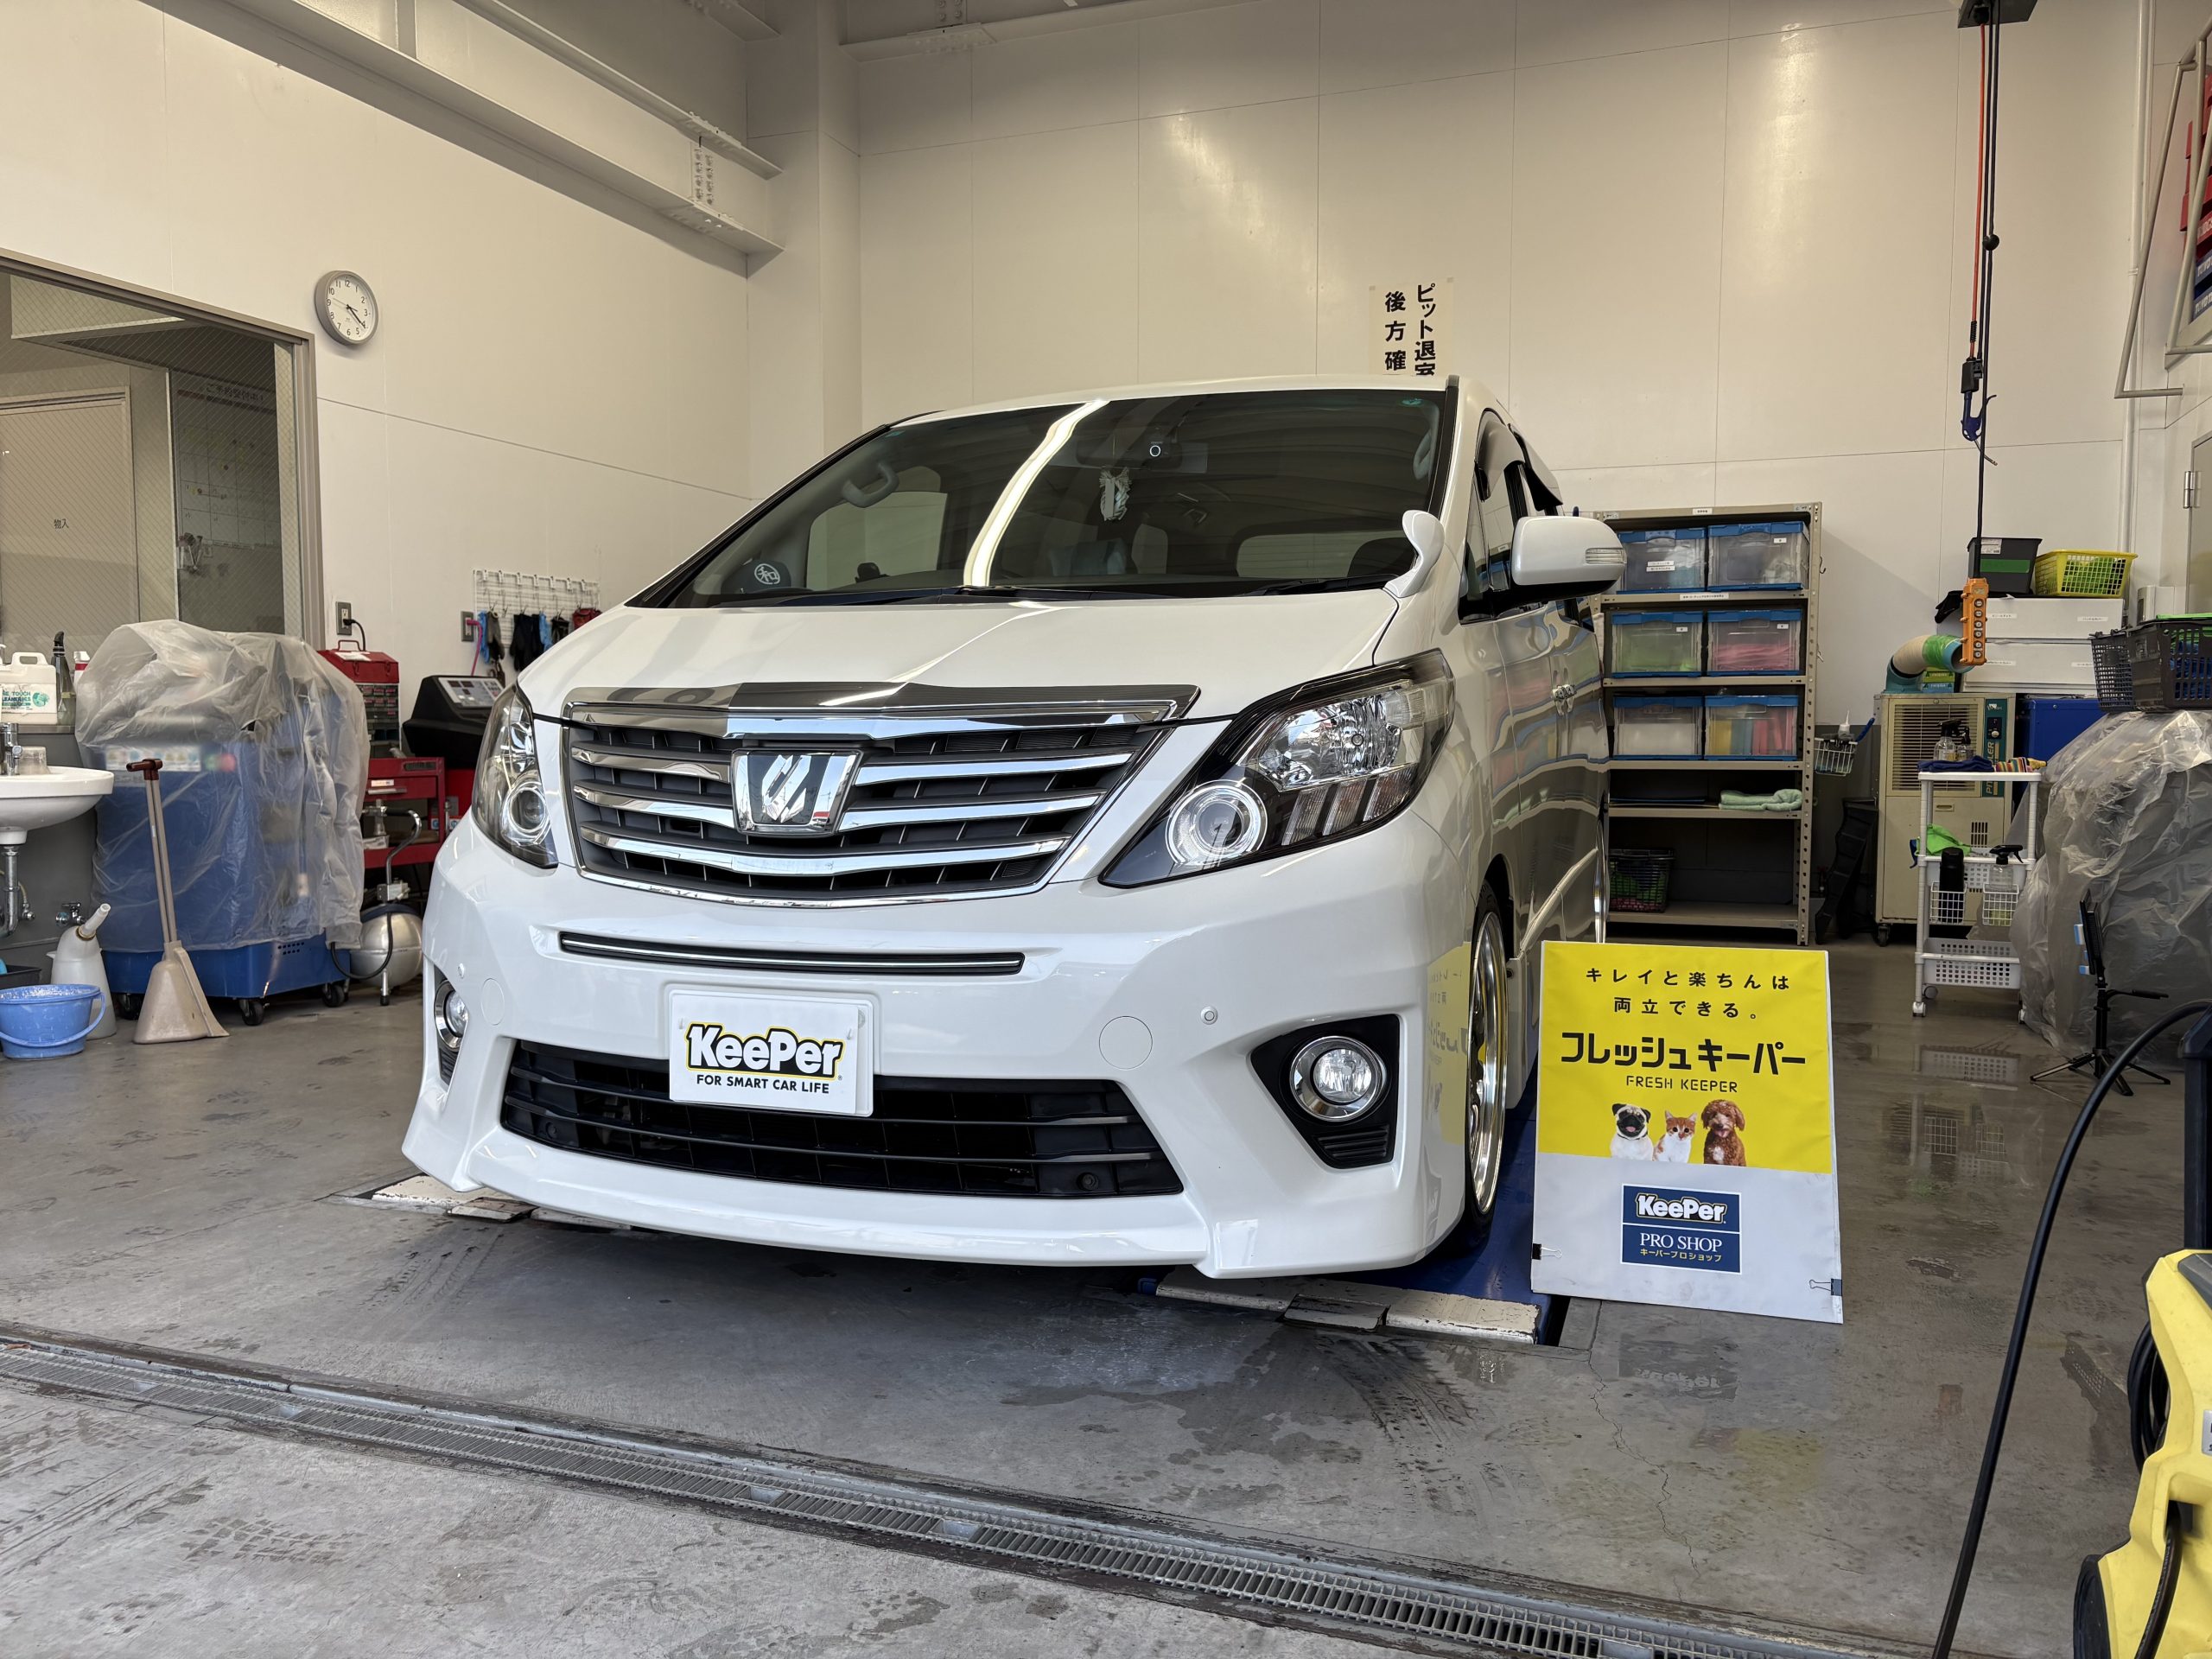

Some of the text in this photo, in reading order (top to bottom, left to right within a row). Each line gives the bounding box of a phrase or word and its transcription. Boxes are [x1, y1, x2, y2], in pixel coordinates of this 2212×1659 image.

[1384, 290, 1406, 371] 後方確
[1586, 967, 1789, 990] キレイと楽ちんは
[1613, 996, 1757, 1020] 両立できる。
[686, 1022, 843, 1079] KeePer
[1560, 1032, 1807, 1076] フレッシュキーパー
[696, 1074, 830, 1094] FOR SMART CAR LIFE
[1626, 1075, 1738, 1093] FRESH KEEPER
[1636, 1193, 1727, 1224] KeePer
[1640, 1232, 1722, 1252] PRO SHOP
[1640, 1248, 1722, 1262] キーパープロショップ
